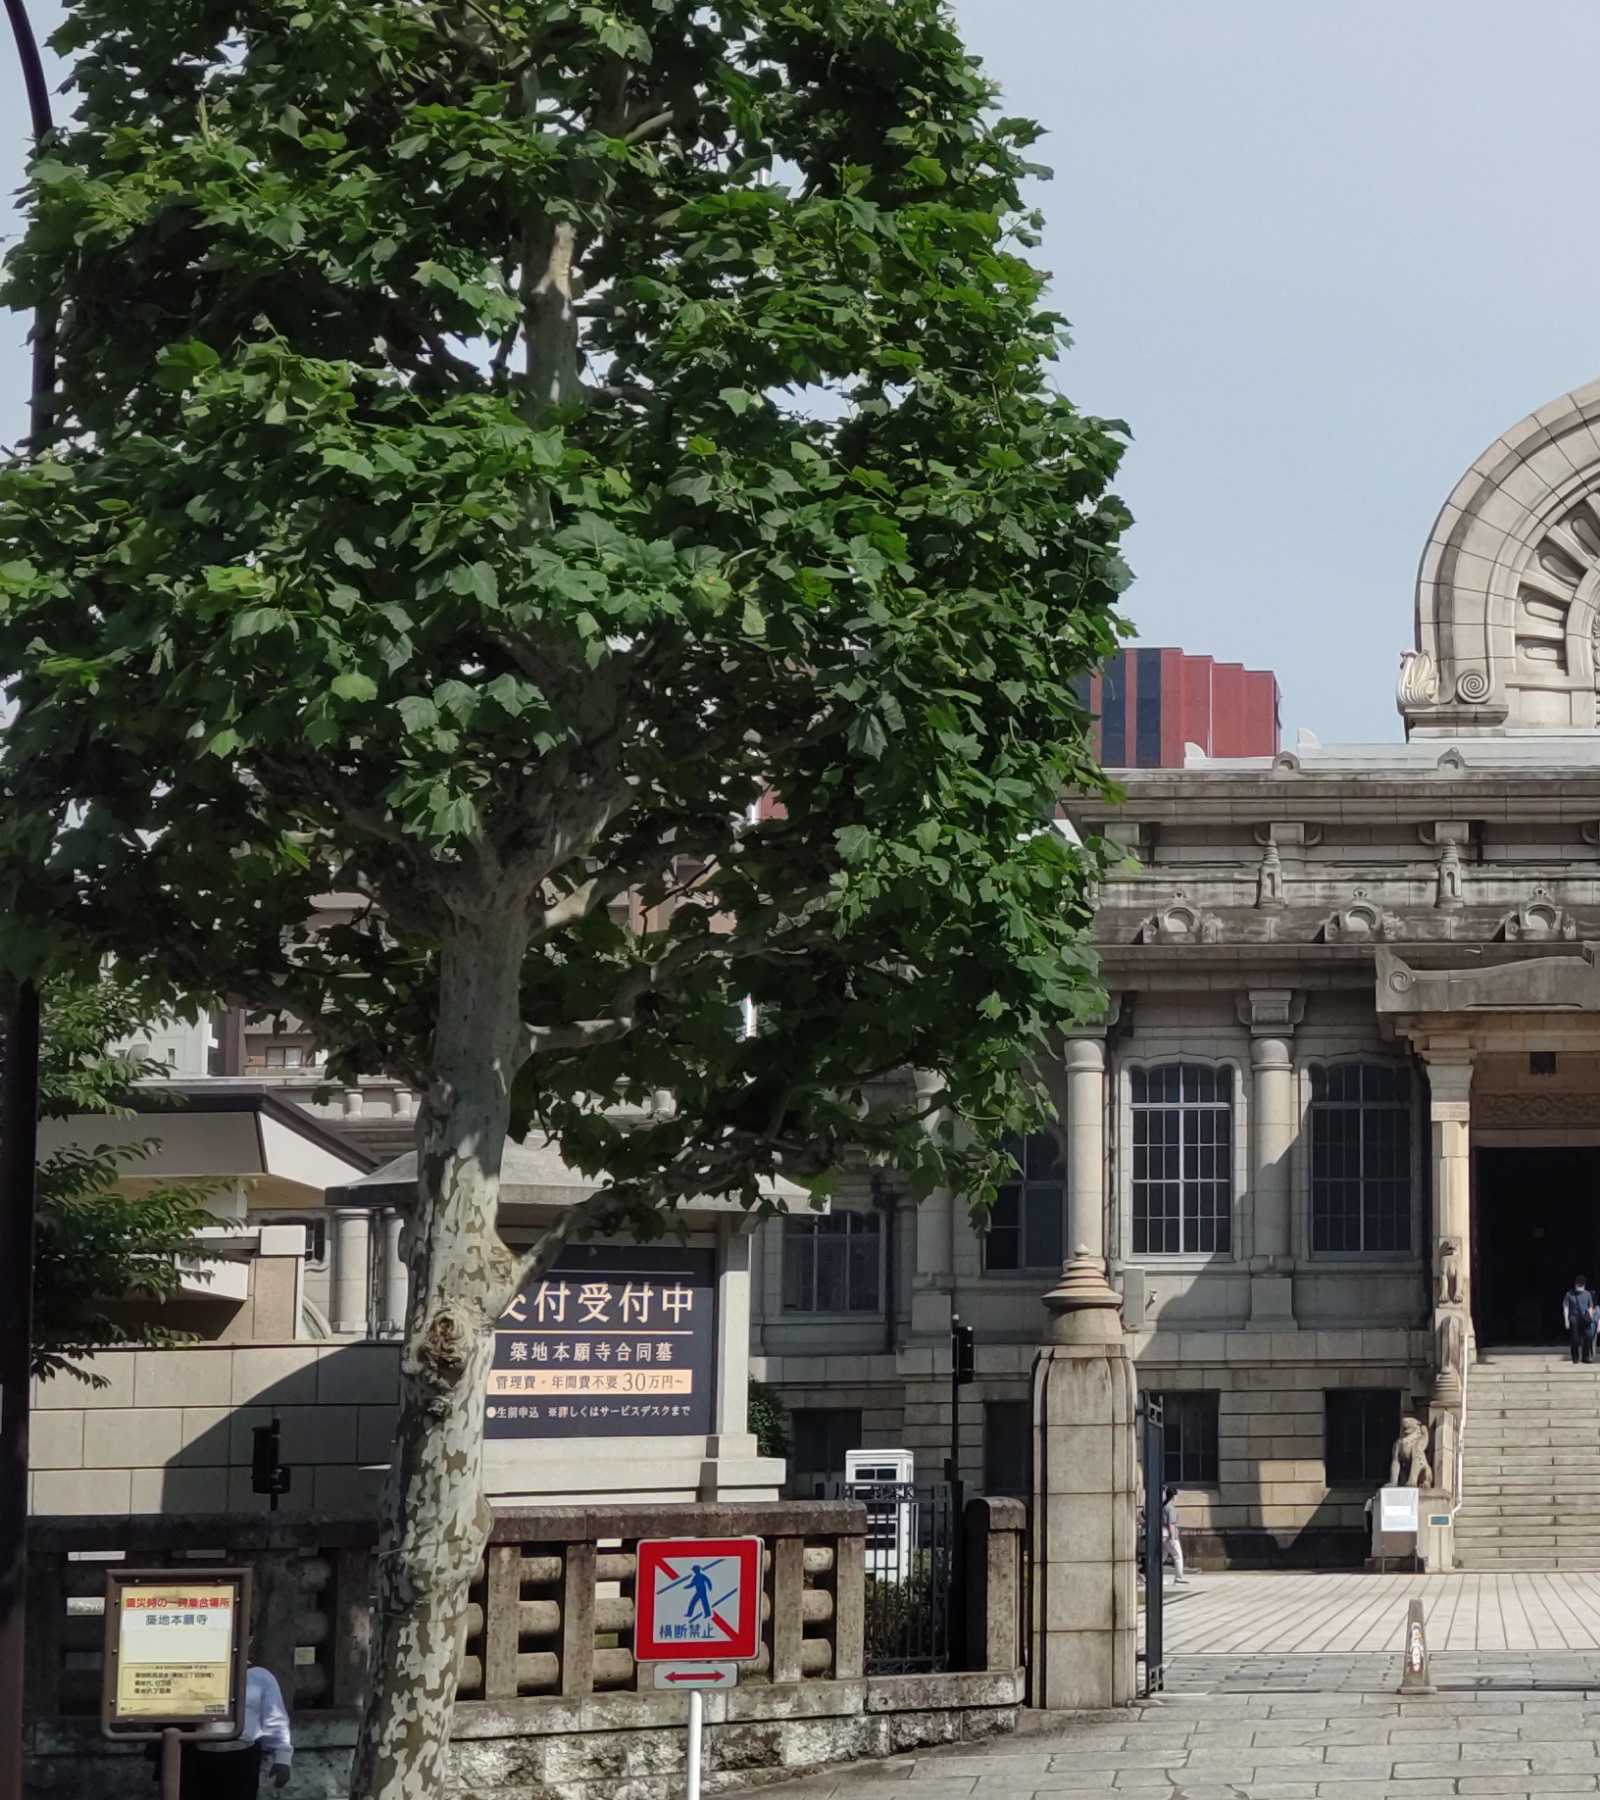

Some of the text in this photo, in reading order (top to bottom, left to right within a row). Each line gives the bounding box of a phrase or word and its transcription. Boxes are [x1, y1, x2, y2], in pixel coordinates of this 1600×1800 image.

[509, 1341, 674, 1362] 築地本願寺合同墓
[145, 1614, 208, 1626] 築地本願寺
[659, 1623, 715, 1639] 横断禁止
